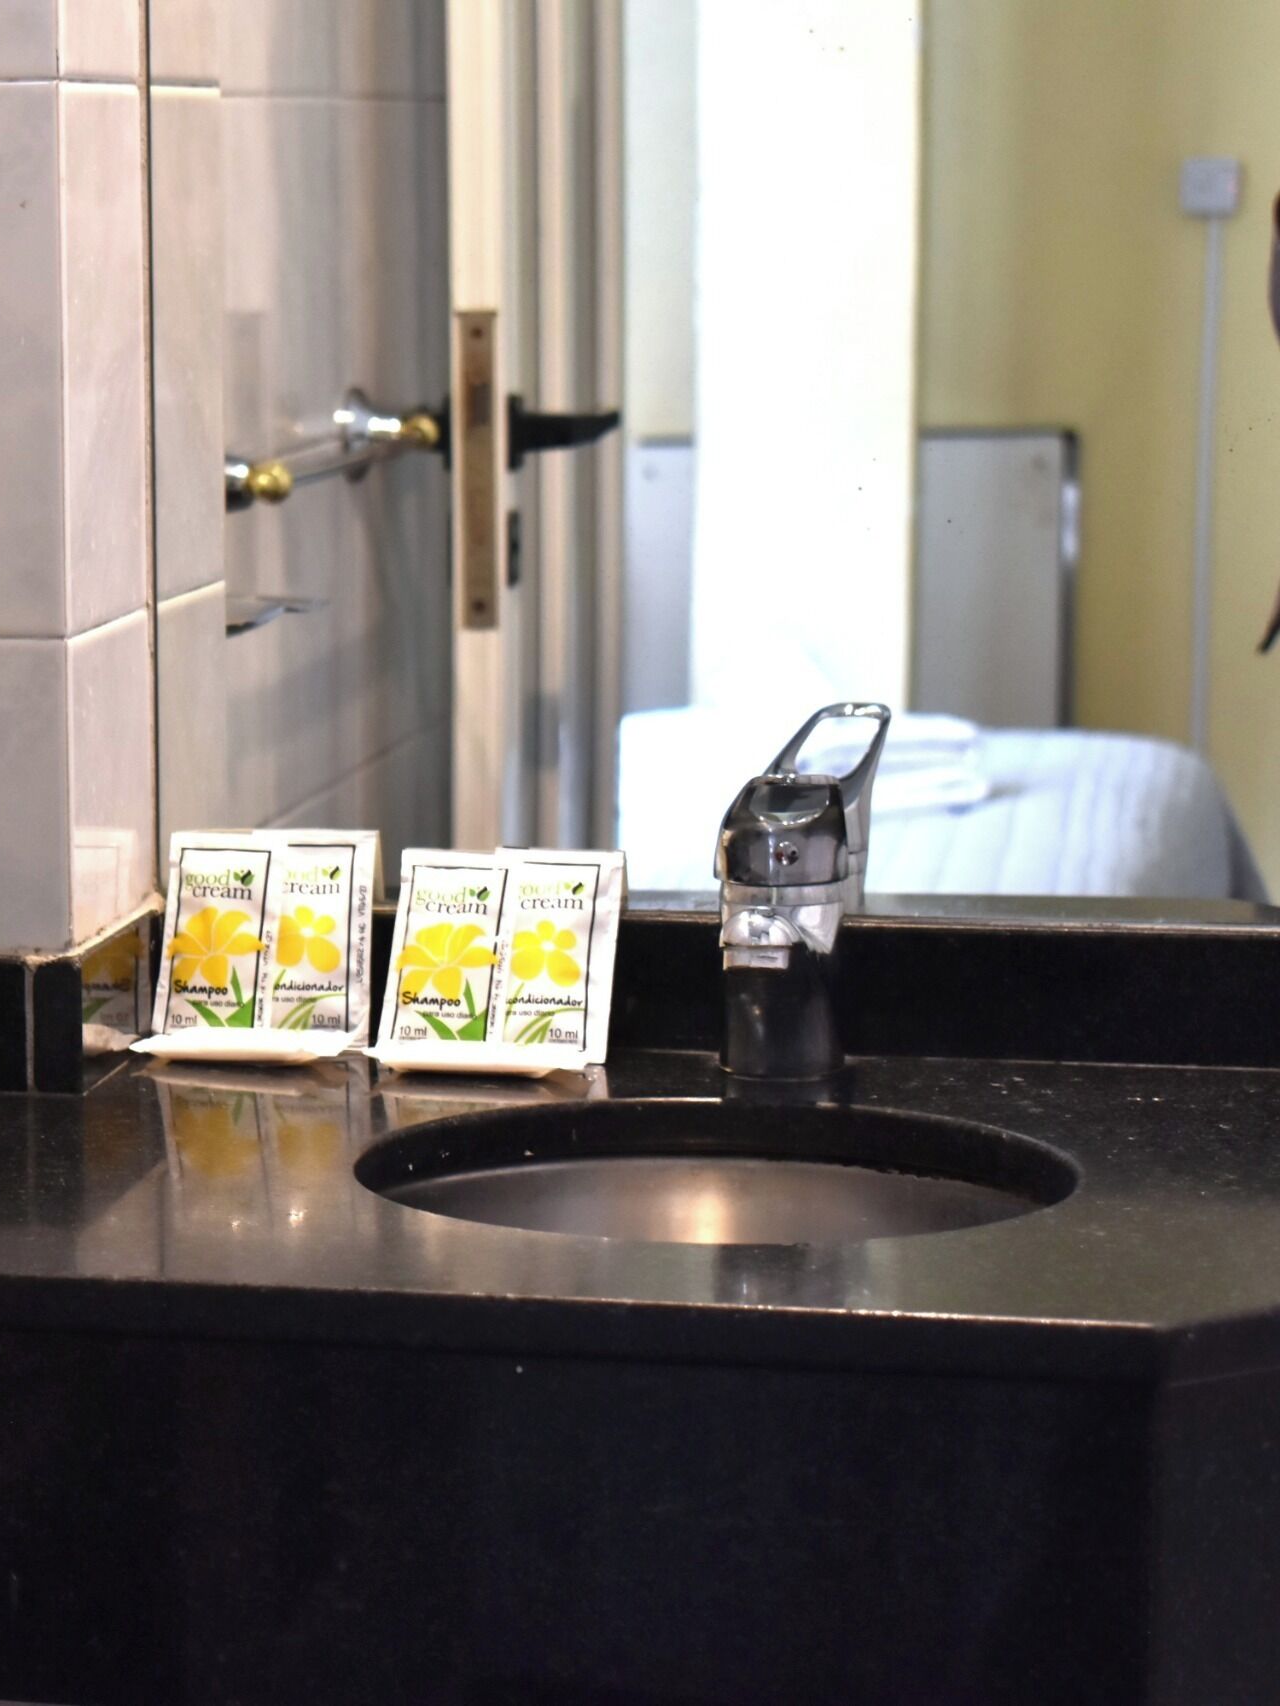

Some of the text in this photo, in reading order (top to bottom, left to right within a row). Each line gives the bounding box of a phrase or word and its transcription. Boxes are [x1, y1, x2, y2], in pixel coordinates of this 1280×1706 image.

[184, 869, 231, 891] good
[192, 885, 253, 901] cream
[424, 900, 488, 916] cream
[521, 897, 584, 910] cream
[174, 979, 229, 999] Shampoo
[401, 991, 462, 1011] Shampoo
[170, 1014, 197, 1025] 10 ml
[312, 1014, 341, 1025] 10 ml
[400, 1025, 428, 1036] 10 ml
[549, 1028, 579, 1040] 10 ml
